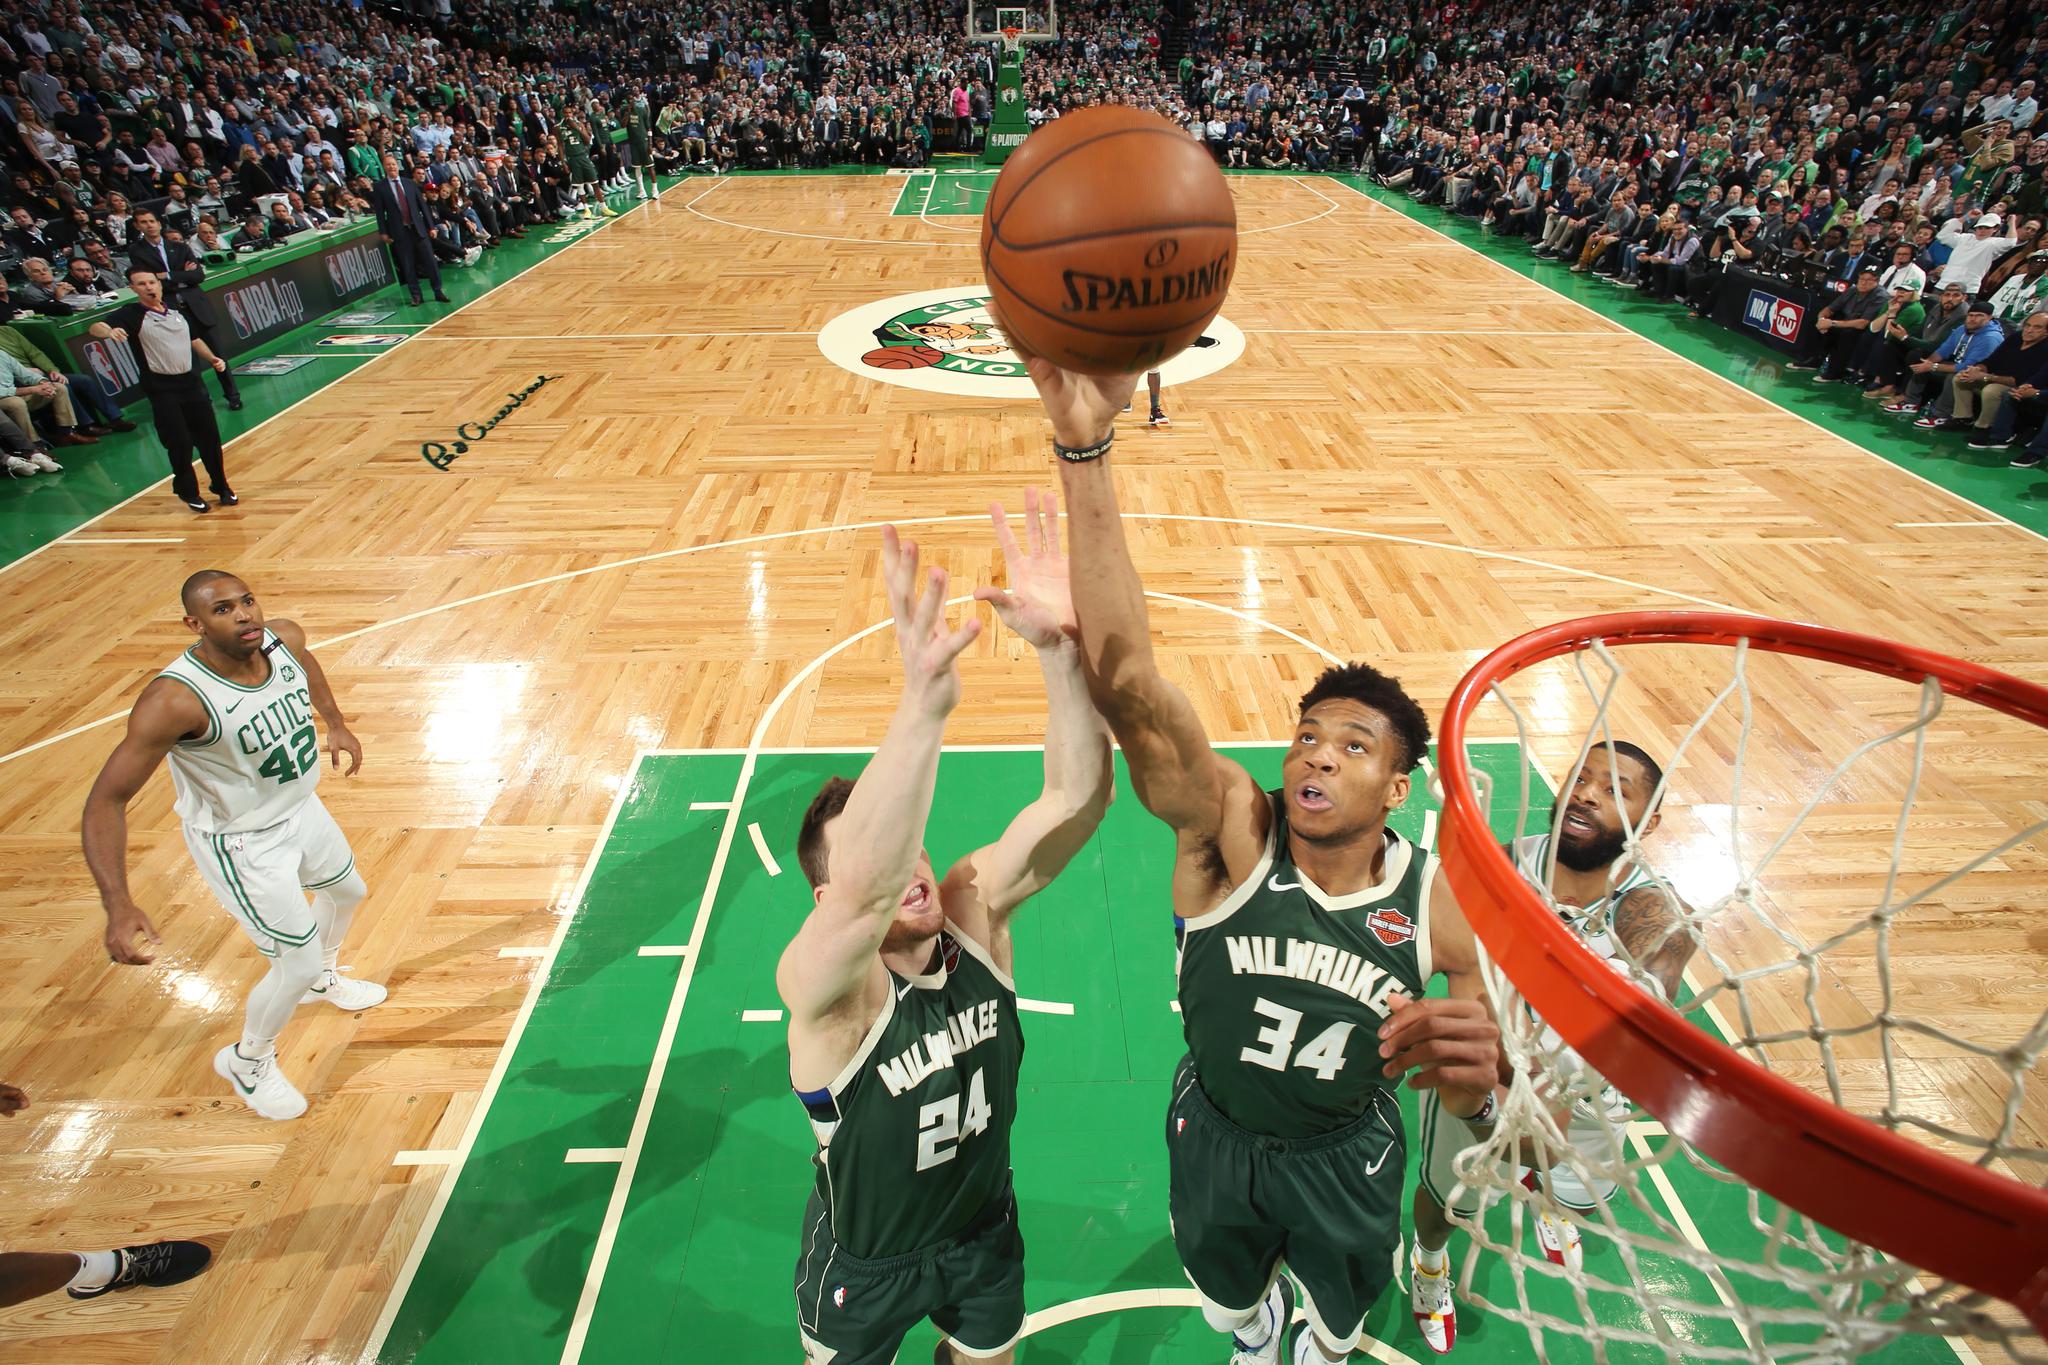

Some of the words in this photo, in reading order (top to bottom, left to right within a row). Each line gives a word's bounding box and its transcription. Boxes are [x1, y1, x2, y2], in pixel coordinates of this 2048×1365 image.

[337, 246, 368, 292] NBA
[363, 244, 386, 287] App
[1061, 249, 1229, 313] SPALDING
[238, 281, 282, 333] NBA
[272, 277, 304, 325] App
[1749, 297, 1769, 322] NBA
[1066, 452, 1080, 460] Up
[258, 724, 318, 785] 42
[1225, 936, 1414, 1020] MILWAUKE
[1239, 996, 1357, 1081] 34
[916, 1066, 992, 1172] 24
